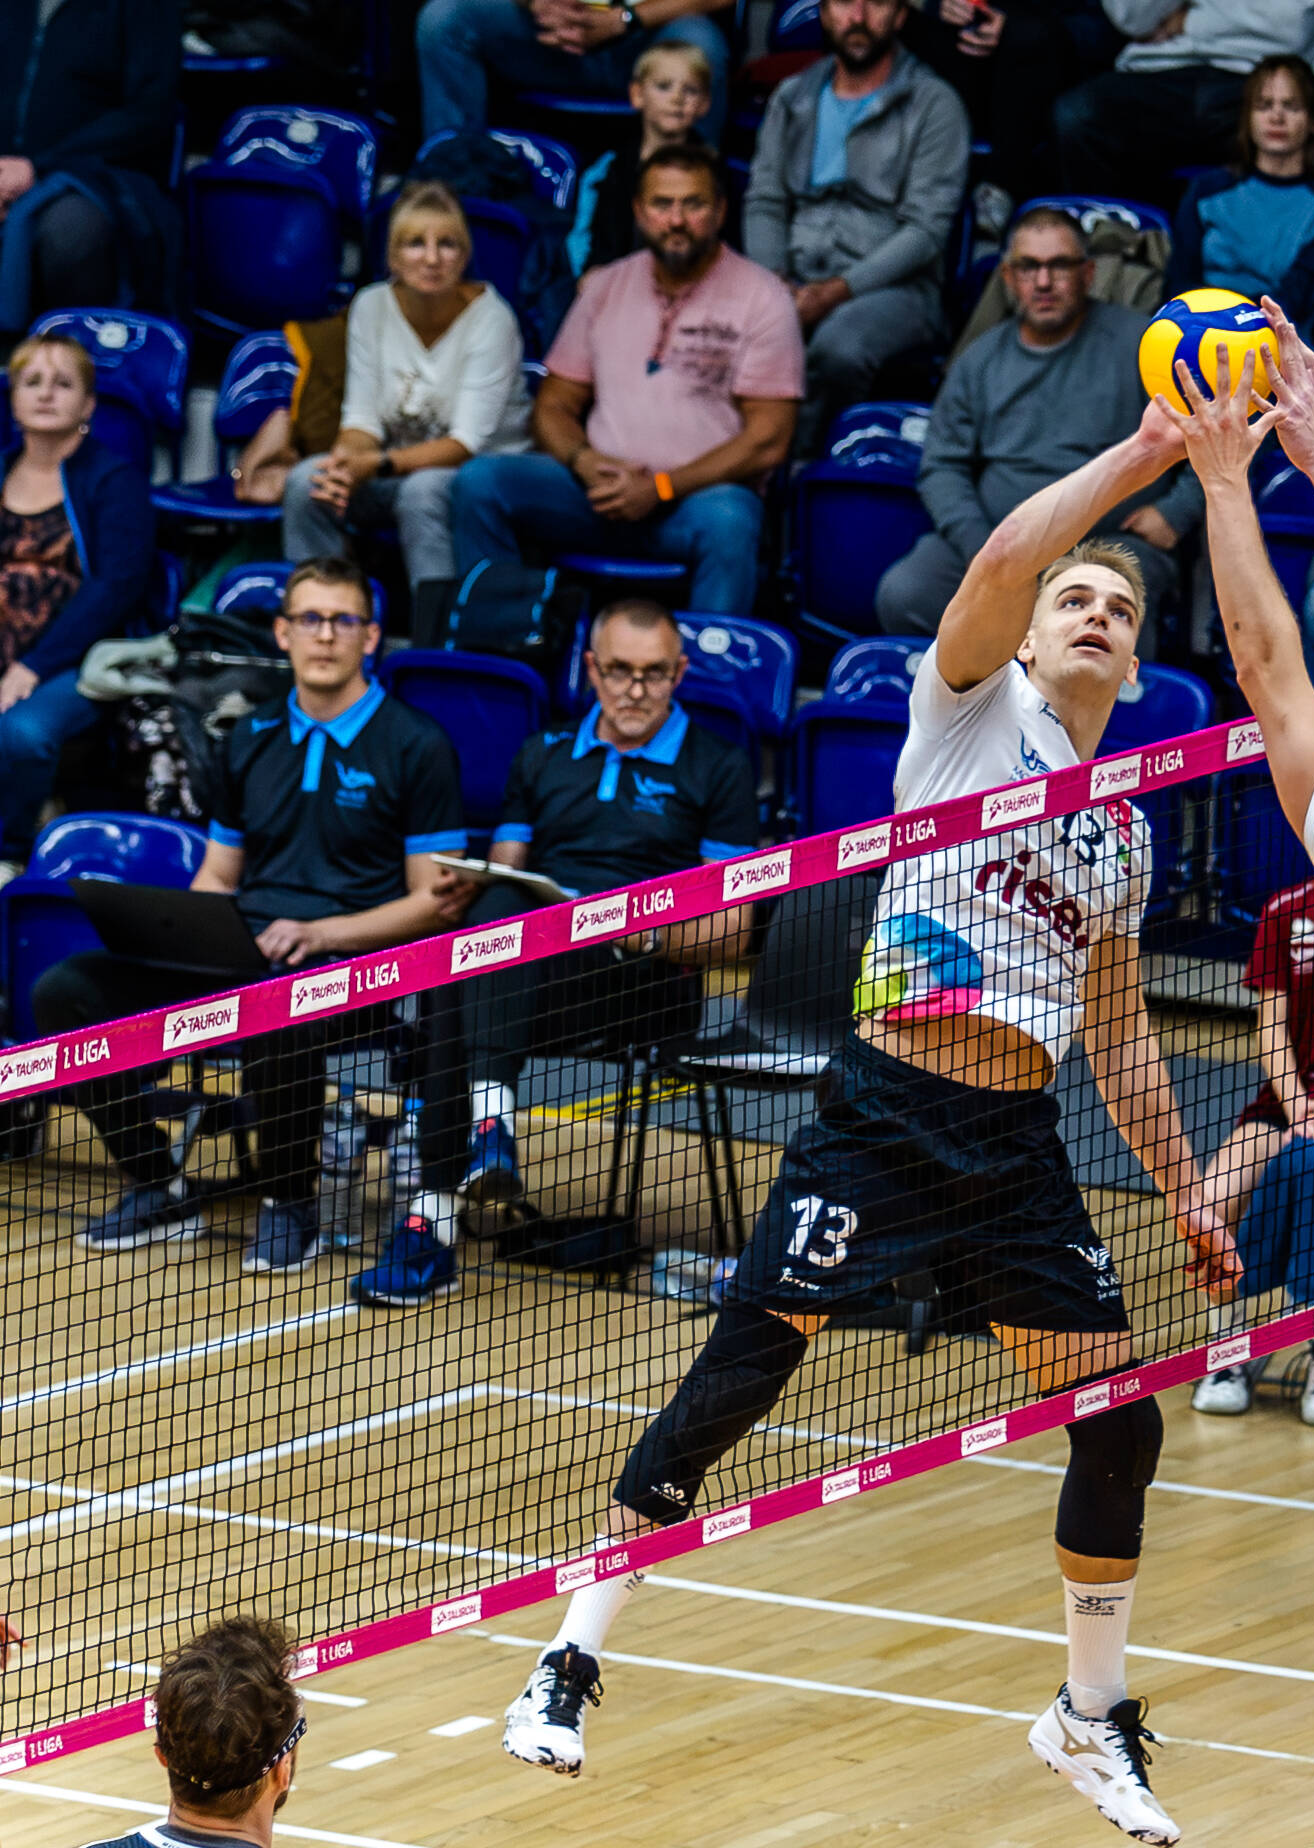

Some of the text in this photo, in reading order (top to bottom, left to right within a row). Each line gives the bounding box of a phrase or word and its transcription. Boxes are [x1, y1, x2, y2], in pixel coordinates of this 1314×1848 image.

[1107, 749, 1184, 786] TAURON 1 LIGA
[1003, 791, 1040, 814] TAURON
[855, 818, 936, 855] TAURON 1 LIGA
[746, 861, 784, 885] TAURON
[590, 888, 674, 927] TAURON 1 LIGA
[474, 934, 515, 958] TAURON
[311, 961, 400, 1001] TAURON 1 LIGA
[188, 1009, 231, 1034] TAURON
[16, 1038, 110, 1078] TAURON 1 LIGA
[787, 1195, 858, 1267] 13
[1119, 1378, 1141, 1396] LIGA
[870, 1463, 891, 1482] LIGA
[606, 1551, 629, 1571] LIGA
[329, 1640, 353, 1661] LIGA
[37, 1735, 64, 1757] LIGA
